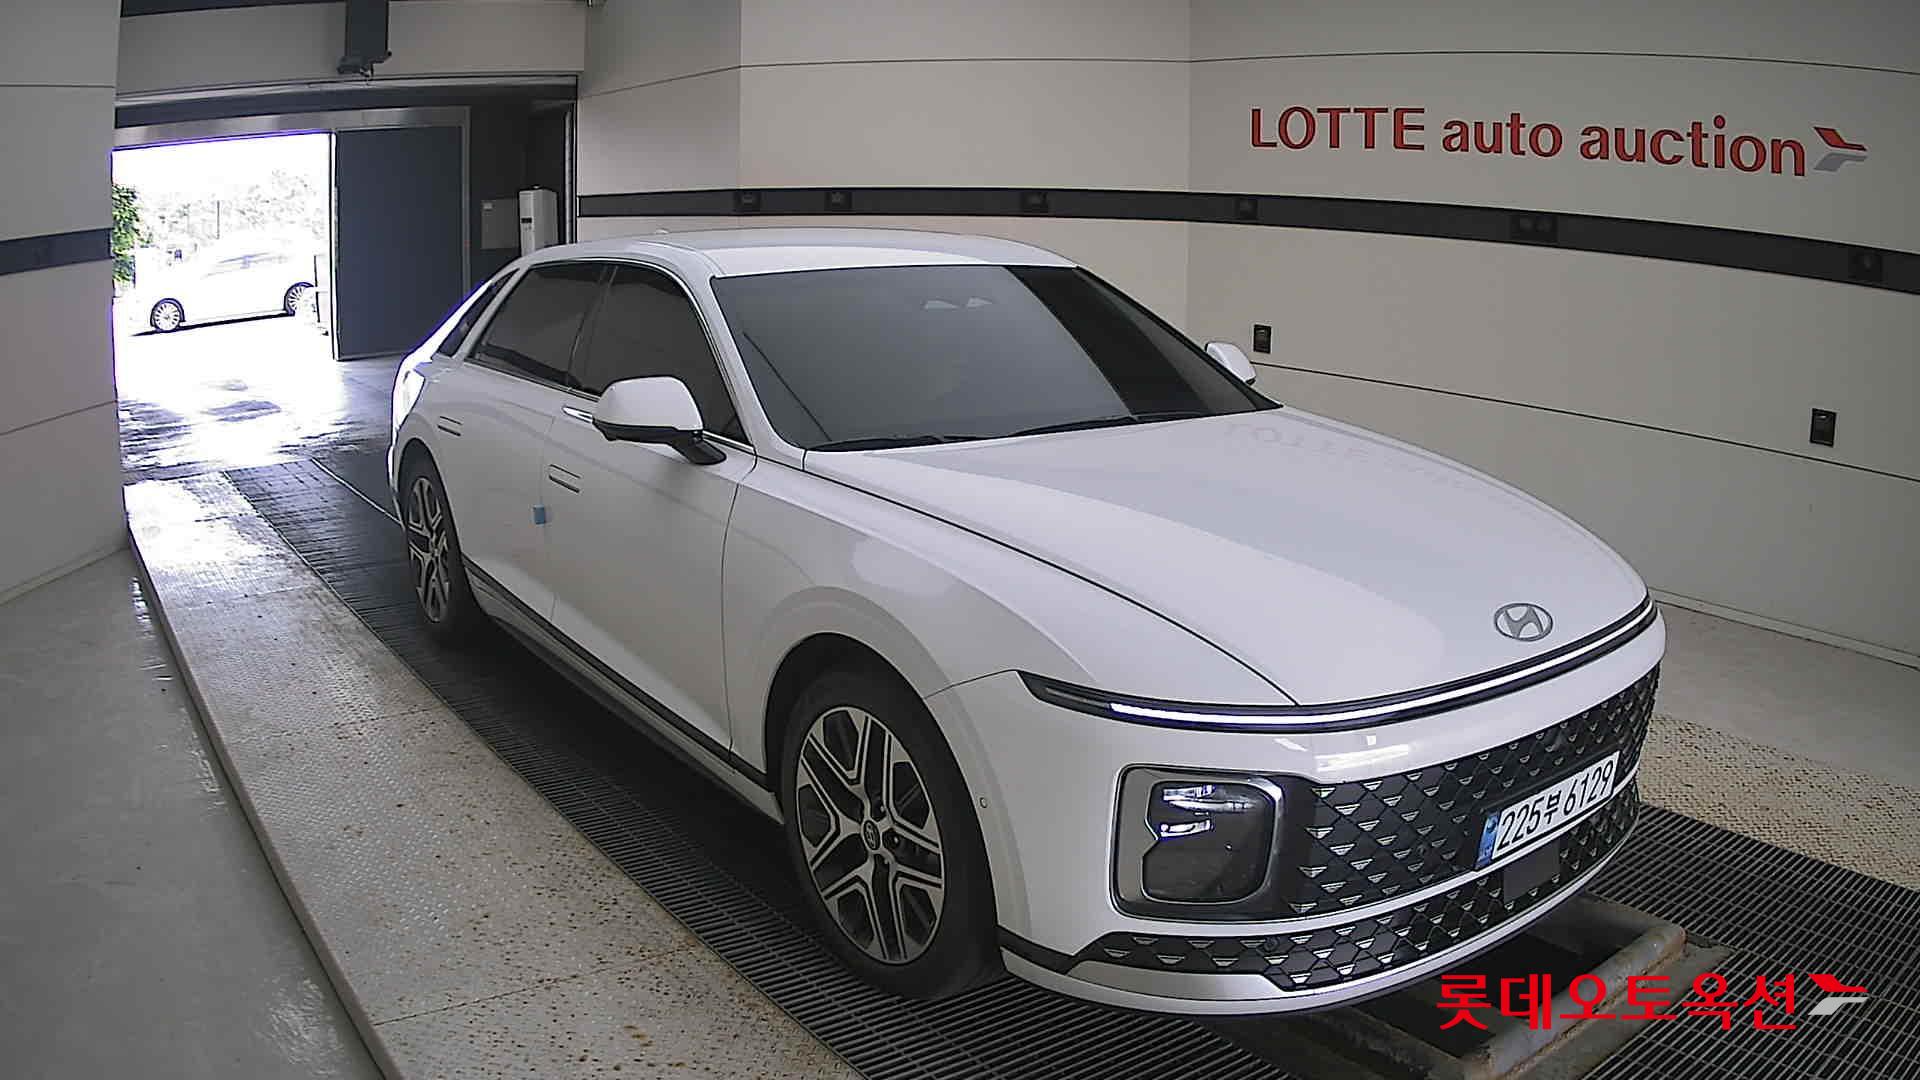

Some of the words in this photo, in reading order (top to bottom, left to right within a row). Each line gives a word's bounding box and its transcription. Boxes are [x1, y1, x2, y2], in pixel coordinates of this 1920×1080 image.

[1251, 106, 1425, 151] LOTTE
[1441, 112, 1564, 158] auto
[1579, 114, 1806, 177] auction
